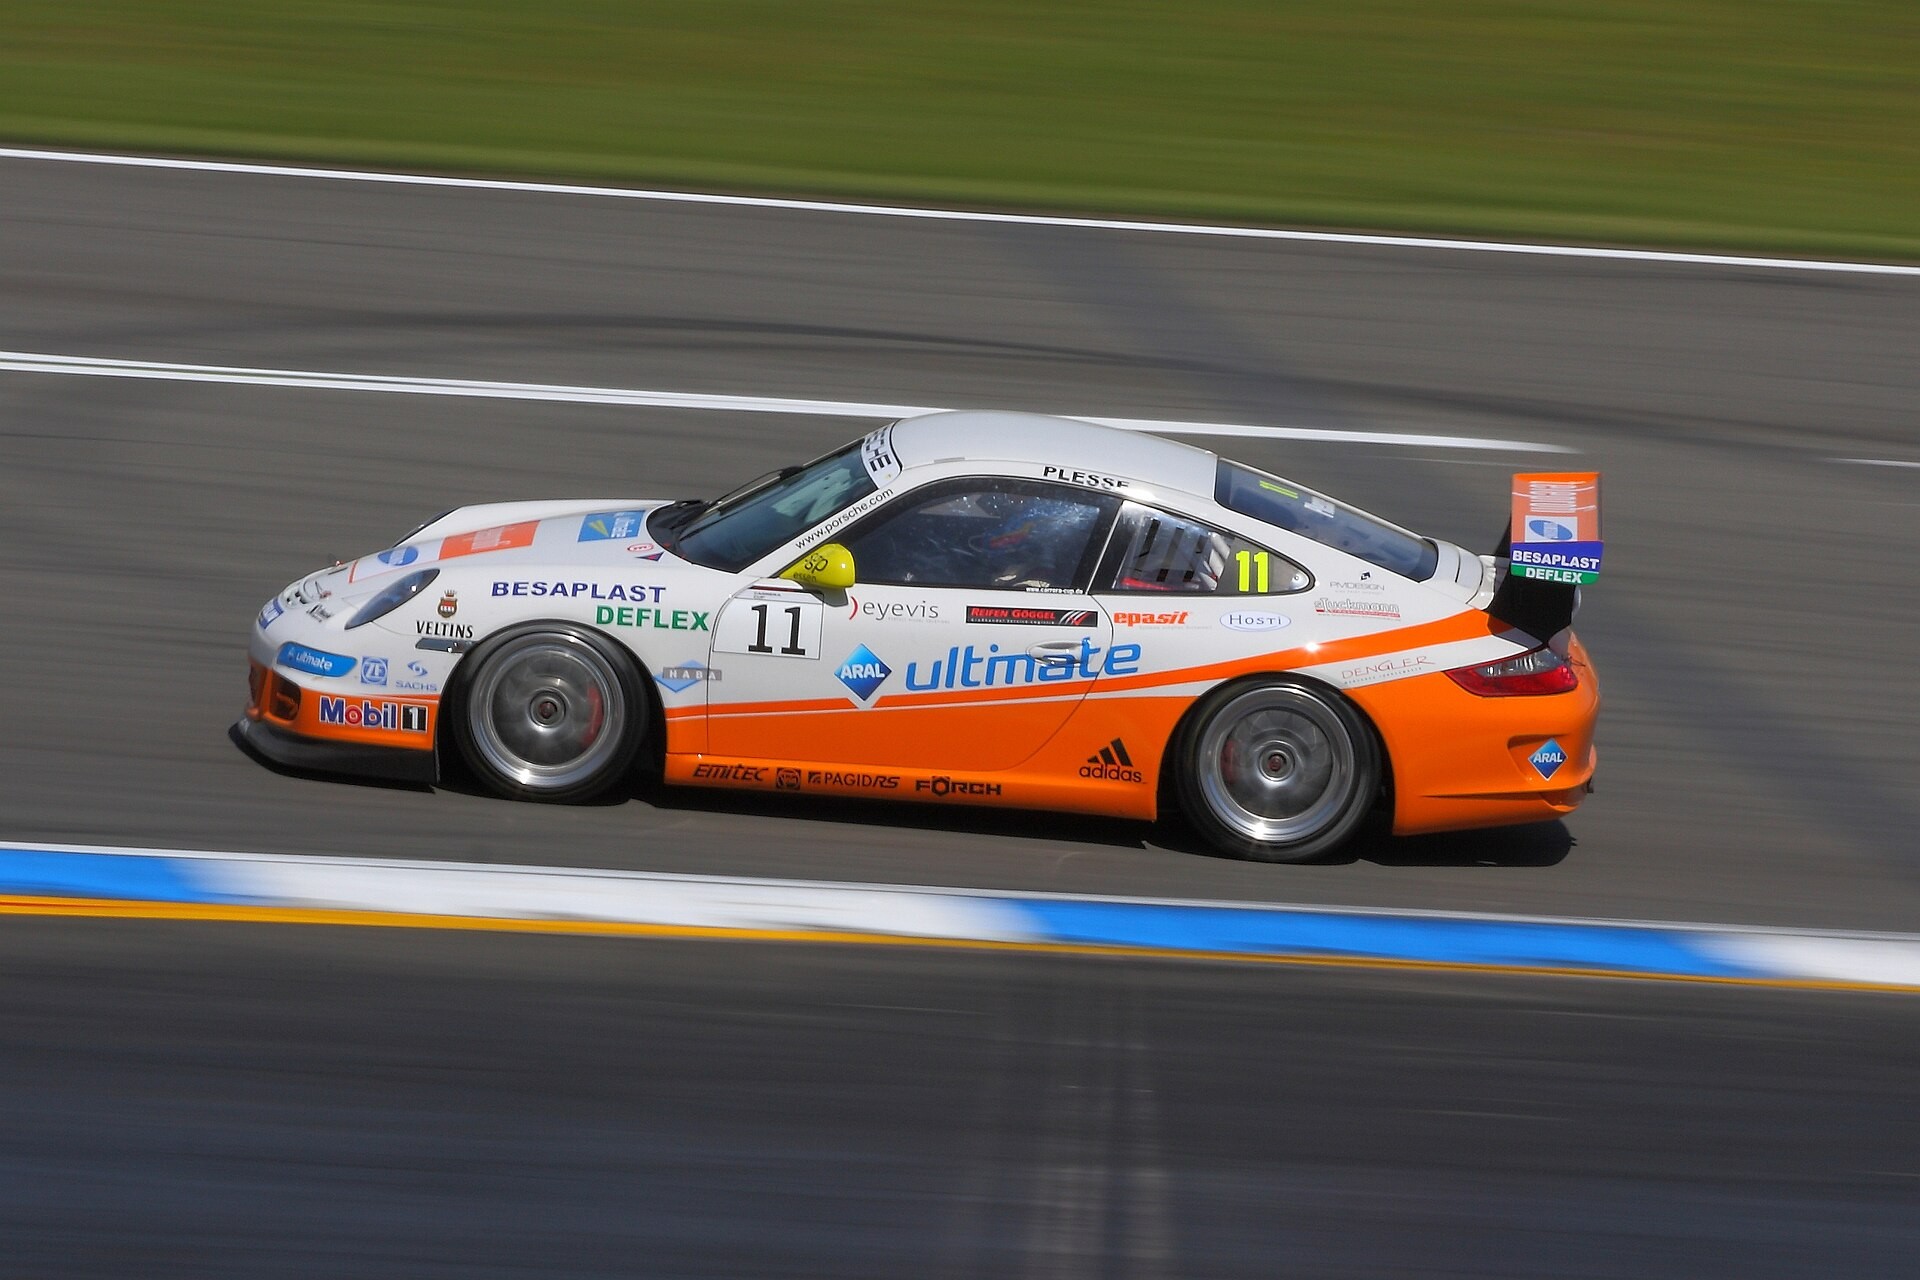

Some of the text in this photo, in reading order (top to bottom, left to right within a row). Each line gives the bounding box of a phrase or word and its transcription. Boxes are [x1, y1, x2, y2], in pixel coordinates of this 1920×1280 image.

[794, 487, 894, 549] www.porsche.com
[1512, 550, 1600, 569] BESAPLAST
[1235, 550, 1270, 593] 11
[1525, 568, 1583, 583] DEFLEX
[491, 582, 667, 603] BESAPLAST
[596, 605, 710, 631] DEFLEX
[863, 600, 939, 621] eyevis
[1114, 611, 1189, 627] epasit
[416, 620, 474, 639] VELTINS
[748, 604, 806, 655] 11
[296, 651, 333, 671] ultimate
[365, 662, 382, 678] ZF
[905, 637, 1141, 691] ultimate
[1342, 655, 1436, 679] DENGLER
[669, 669, 716, 680] HABA
[840, 663, 885, 680] ARAL
[396, 680, 438, 691] SACHS
[319, 695, 397, 730] Mobil
[1533, 752, 1563, 763] ARAL
[1079, 763, 1142, 783] adidas
